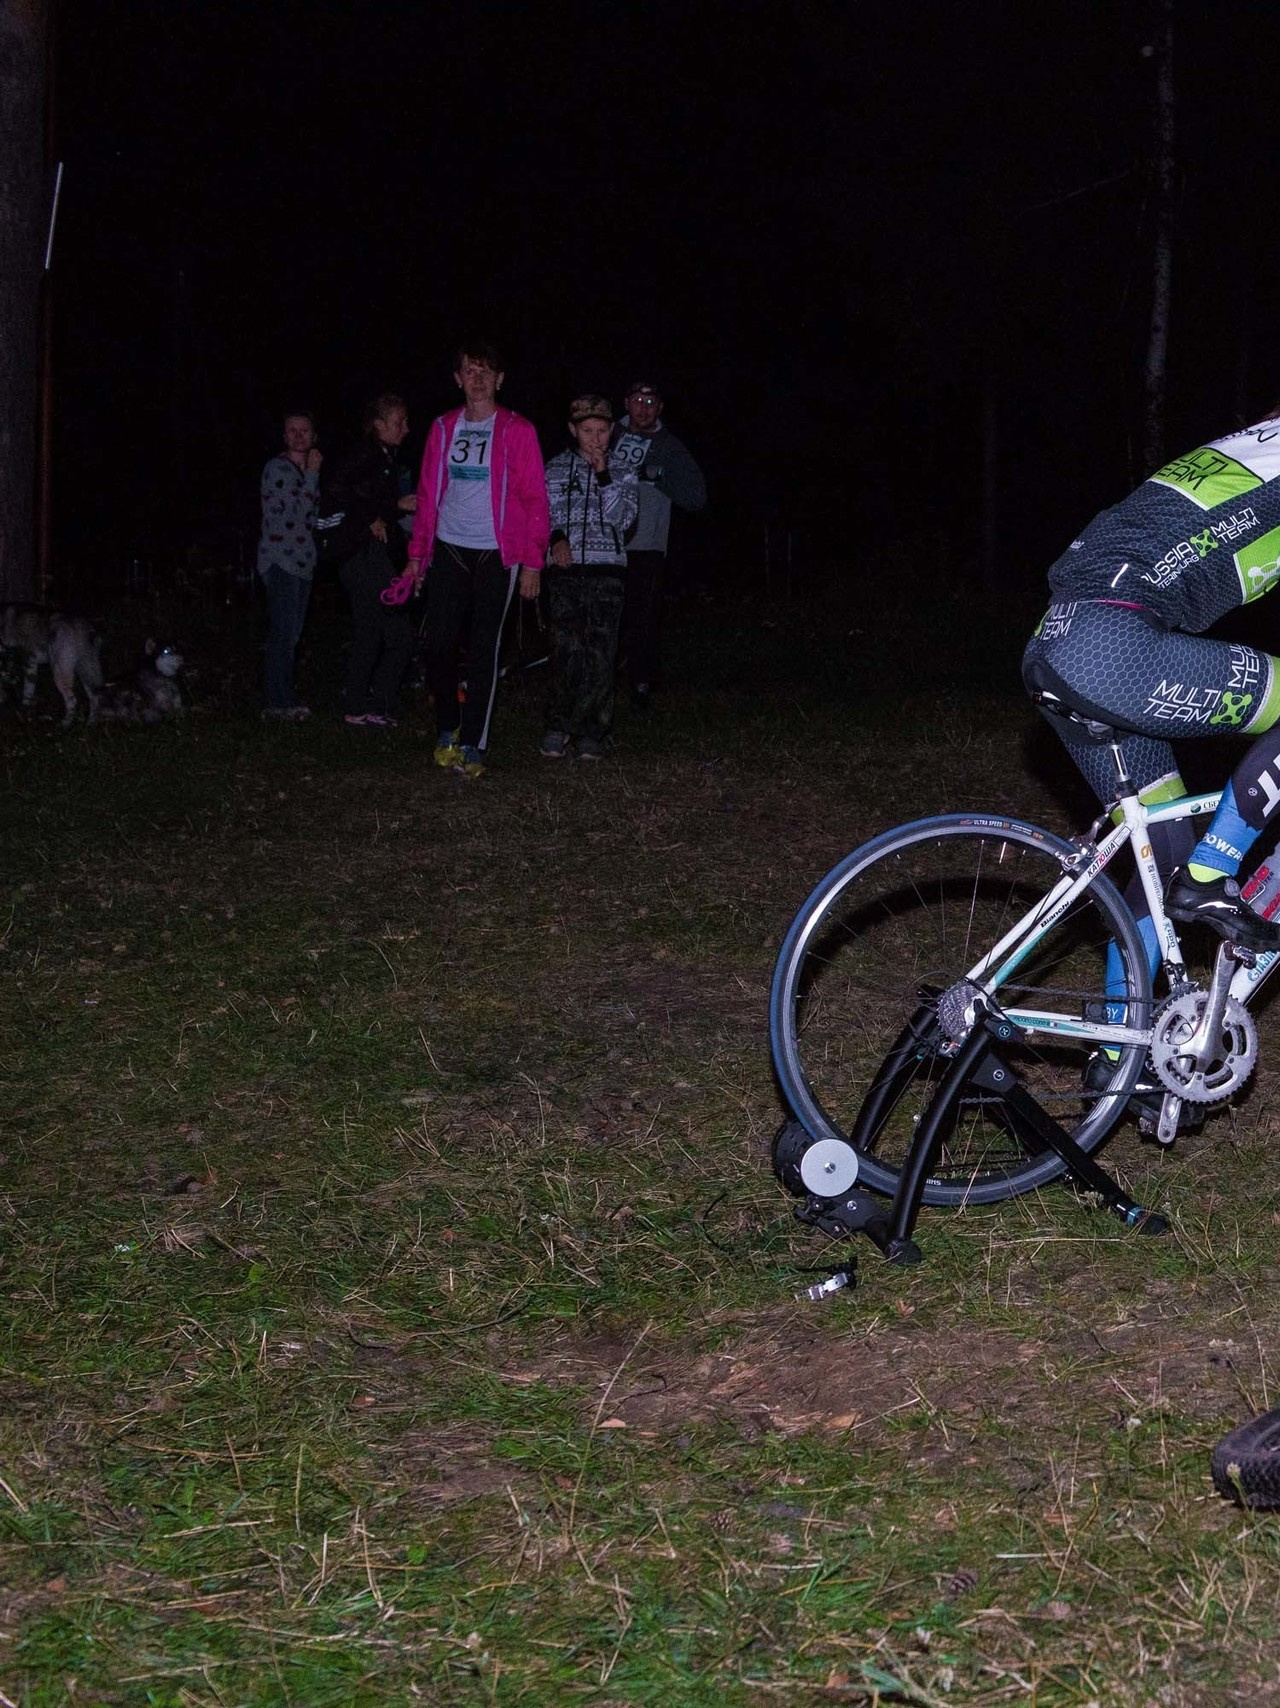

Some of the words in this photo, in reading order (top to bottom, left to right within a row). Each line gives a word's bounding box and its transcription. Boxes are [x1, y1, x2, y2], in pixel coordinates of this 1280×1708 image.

[451, 439, 487, 465] 31
[617, 443, 645, 465] 59
[1179, 450, 1229, 476] ULTI
[1157, 461, 1209, 491] EAM
[1210, 506, 1255, 536] MULTI
[1216, 516, 1261, 544] TEAM
[1152, 679, 1222, 709] MULTI
[1143, 697, 1213, 725] TEAM
[1086, 842, 1116, 878] КАТЮША
